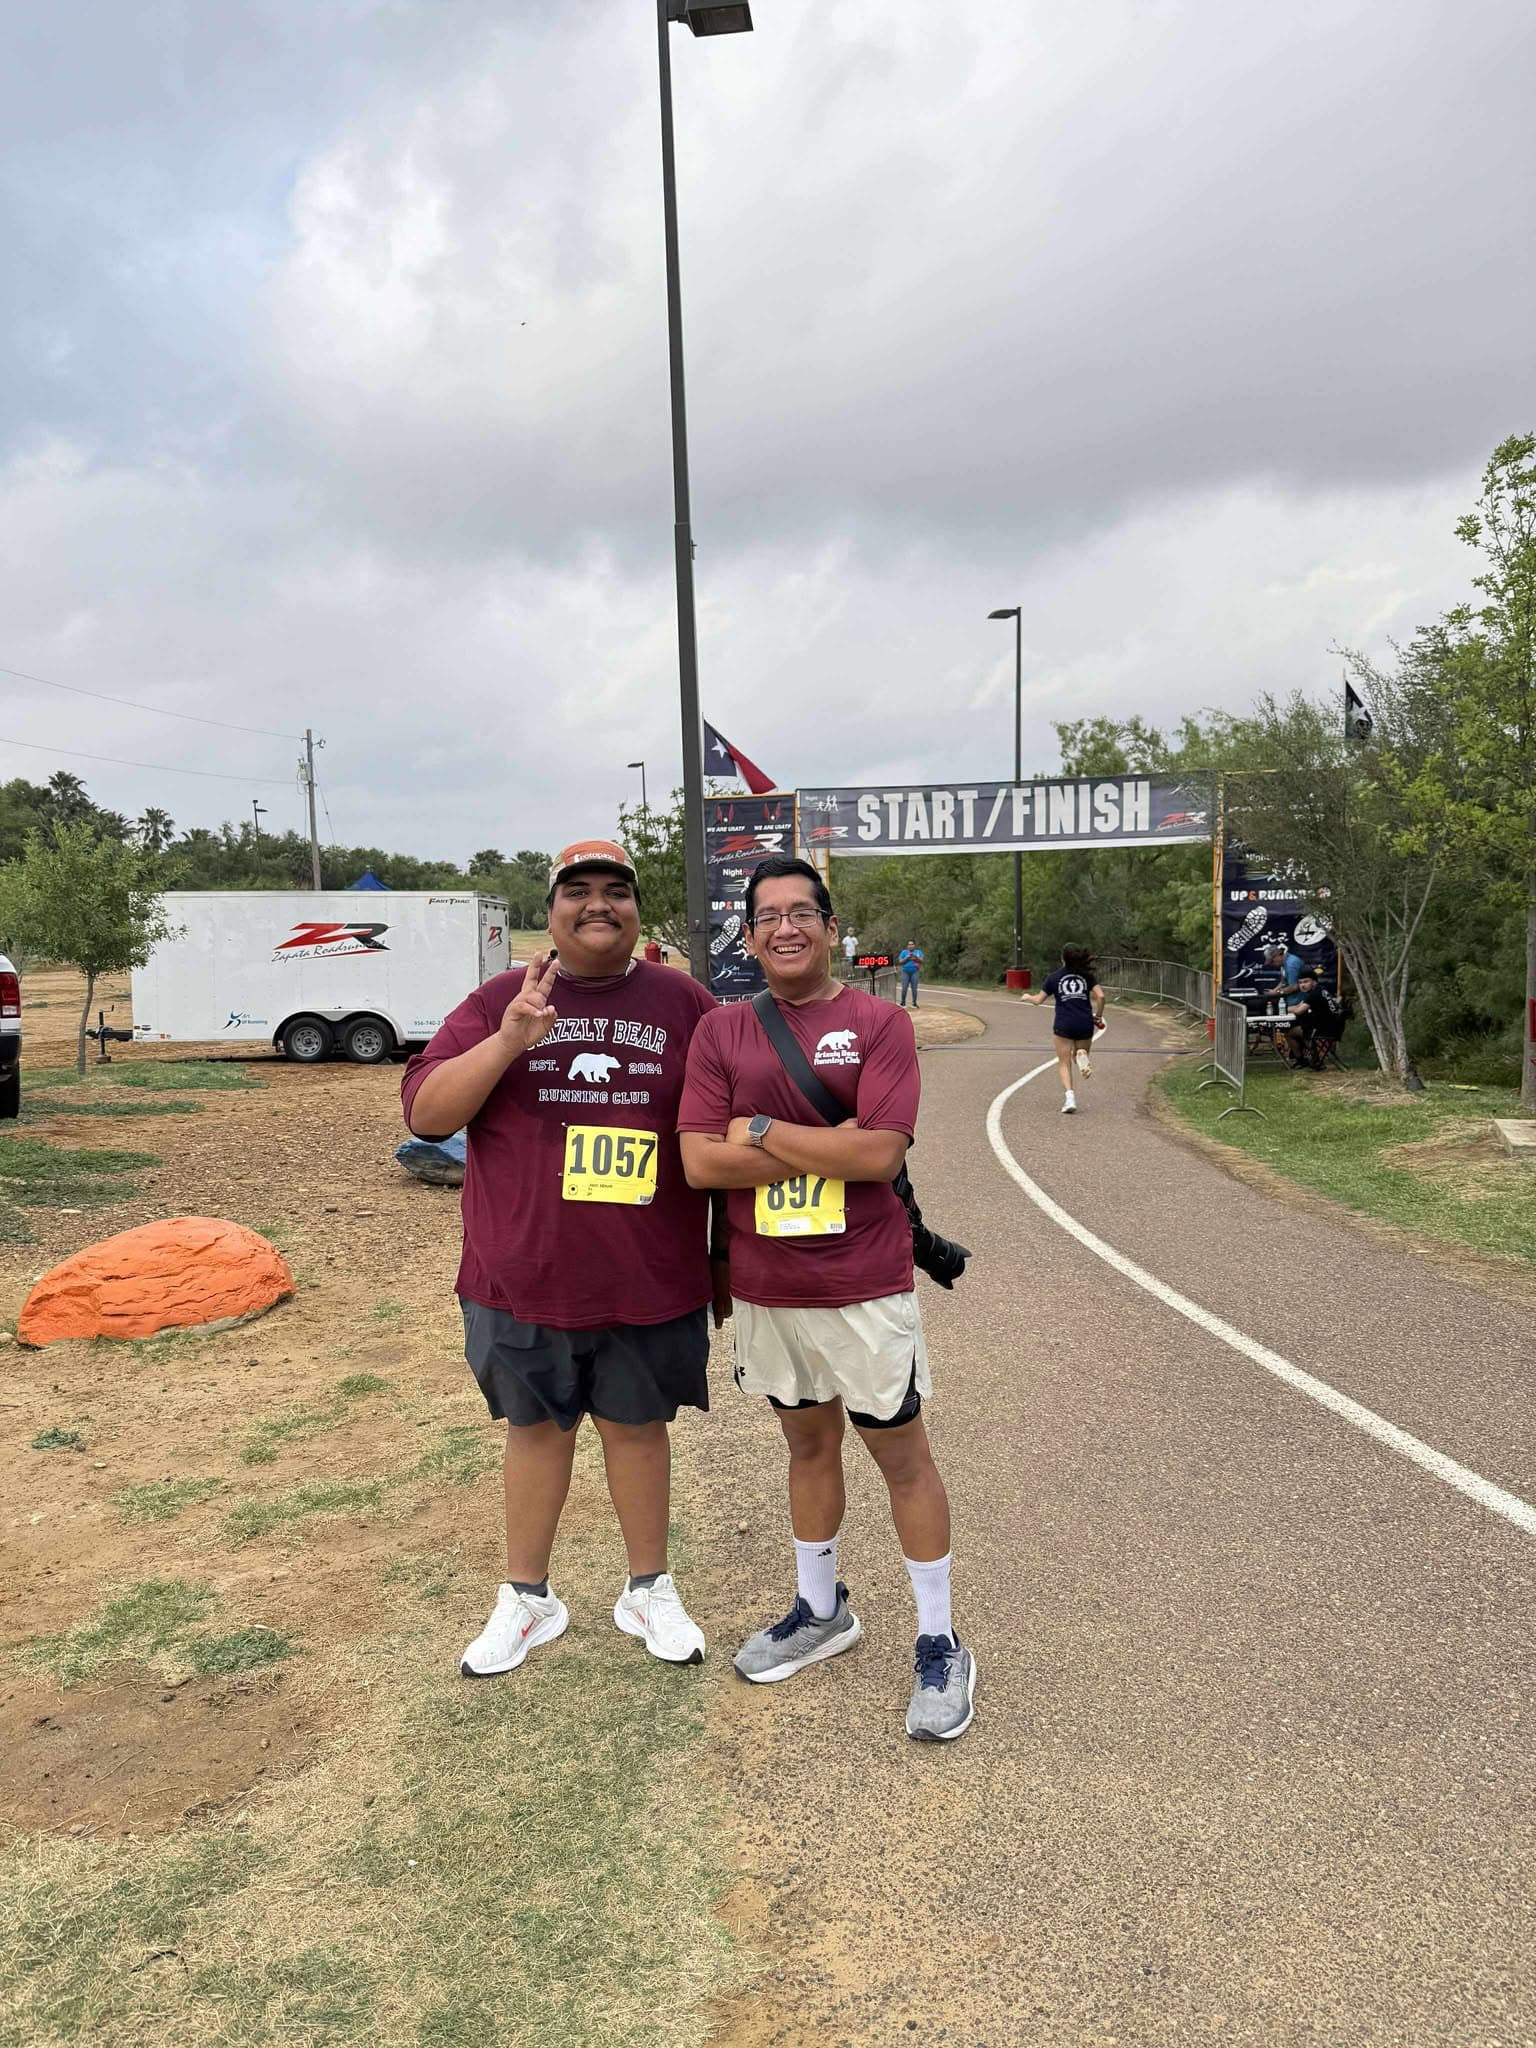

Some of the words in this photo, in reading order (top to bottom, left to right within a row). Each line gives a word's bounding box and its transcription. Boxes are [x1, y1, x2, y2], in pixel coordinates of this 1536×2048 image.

[271, 951, 311, 963] Zapata
[612, 1020, 667, 1055] BEAR
[528, 1060, 560, 1071] EST.
[629, 1063, 662, 1075] 2024
[539, 1088, 608, 1104] RUNNING
[612, 1091, 650, 1105] CLUB
[570, 1133, 656, 1179] 1057
